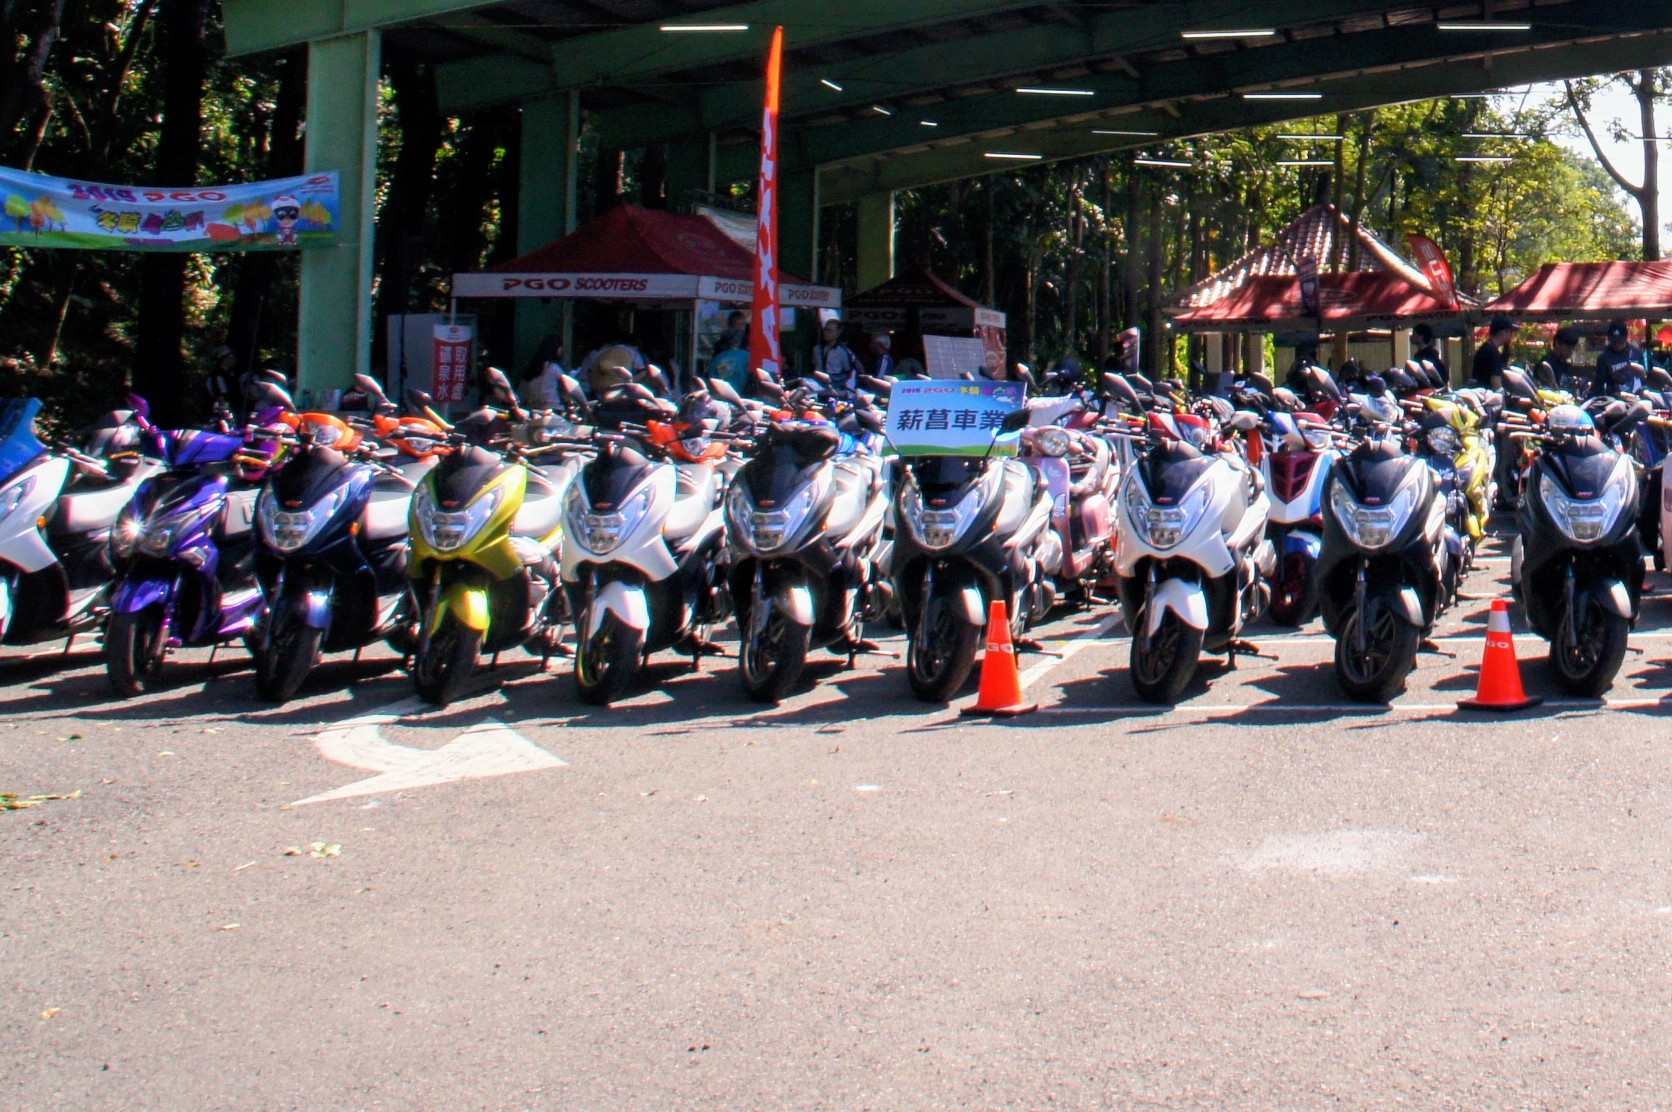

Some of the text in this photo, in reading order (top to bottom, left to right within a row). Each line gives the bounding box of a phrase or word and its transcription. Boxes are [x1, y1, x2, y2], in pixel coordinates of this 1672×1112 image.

[503, 277, 649, 291] PGO SCOOTERS
[715, 282, 736, 294] PGO
[788, 289, 809, 300] PGO
[897, 408, 1008, 432] 薪菖車業
